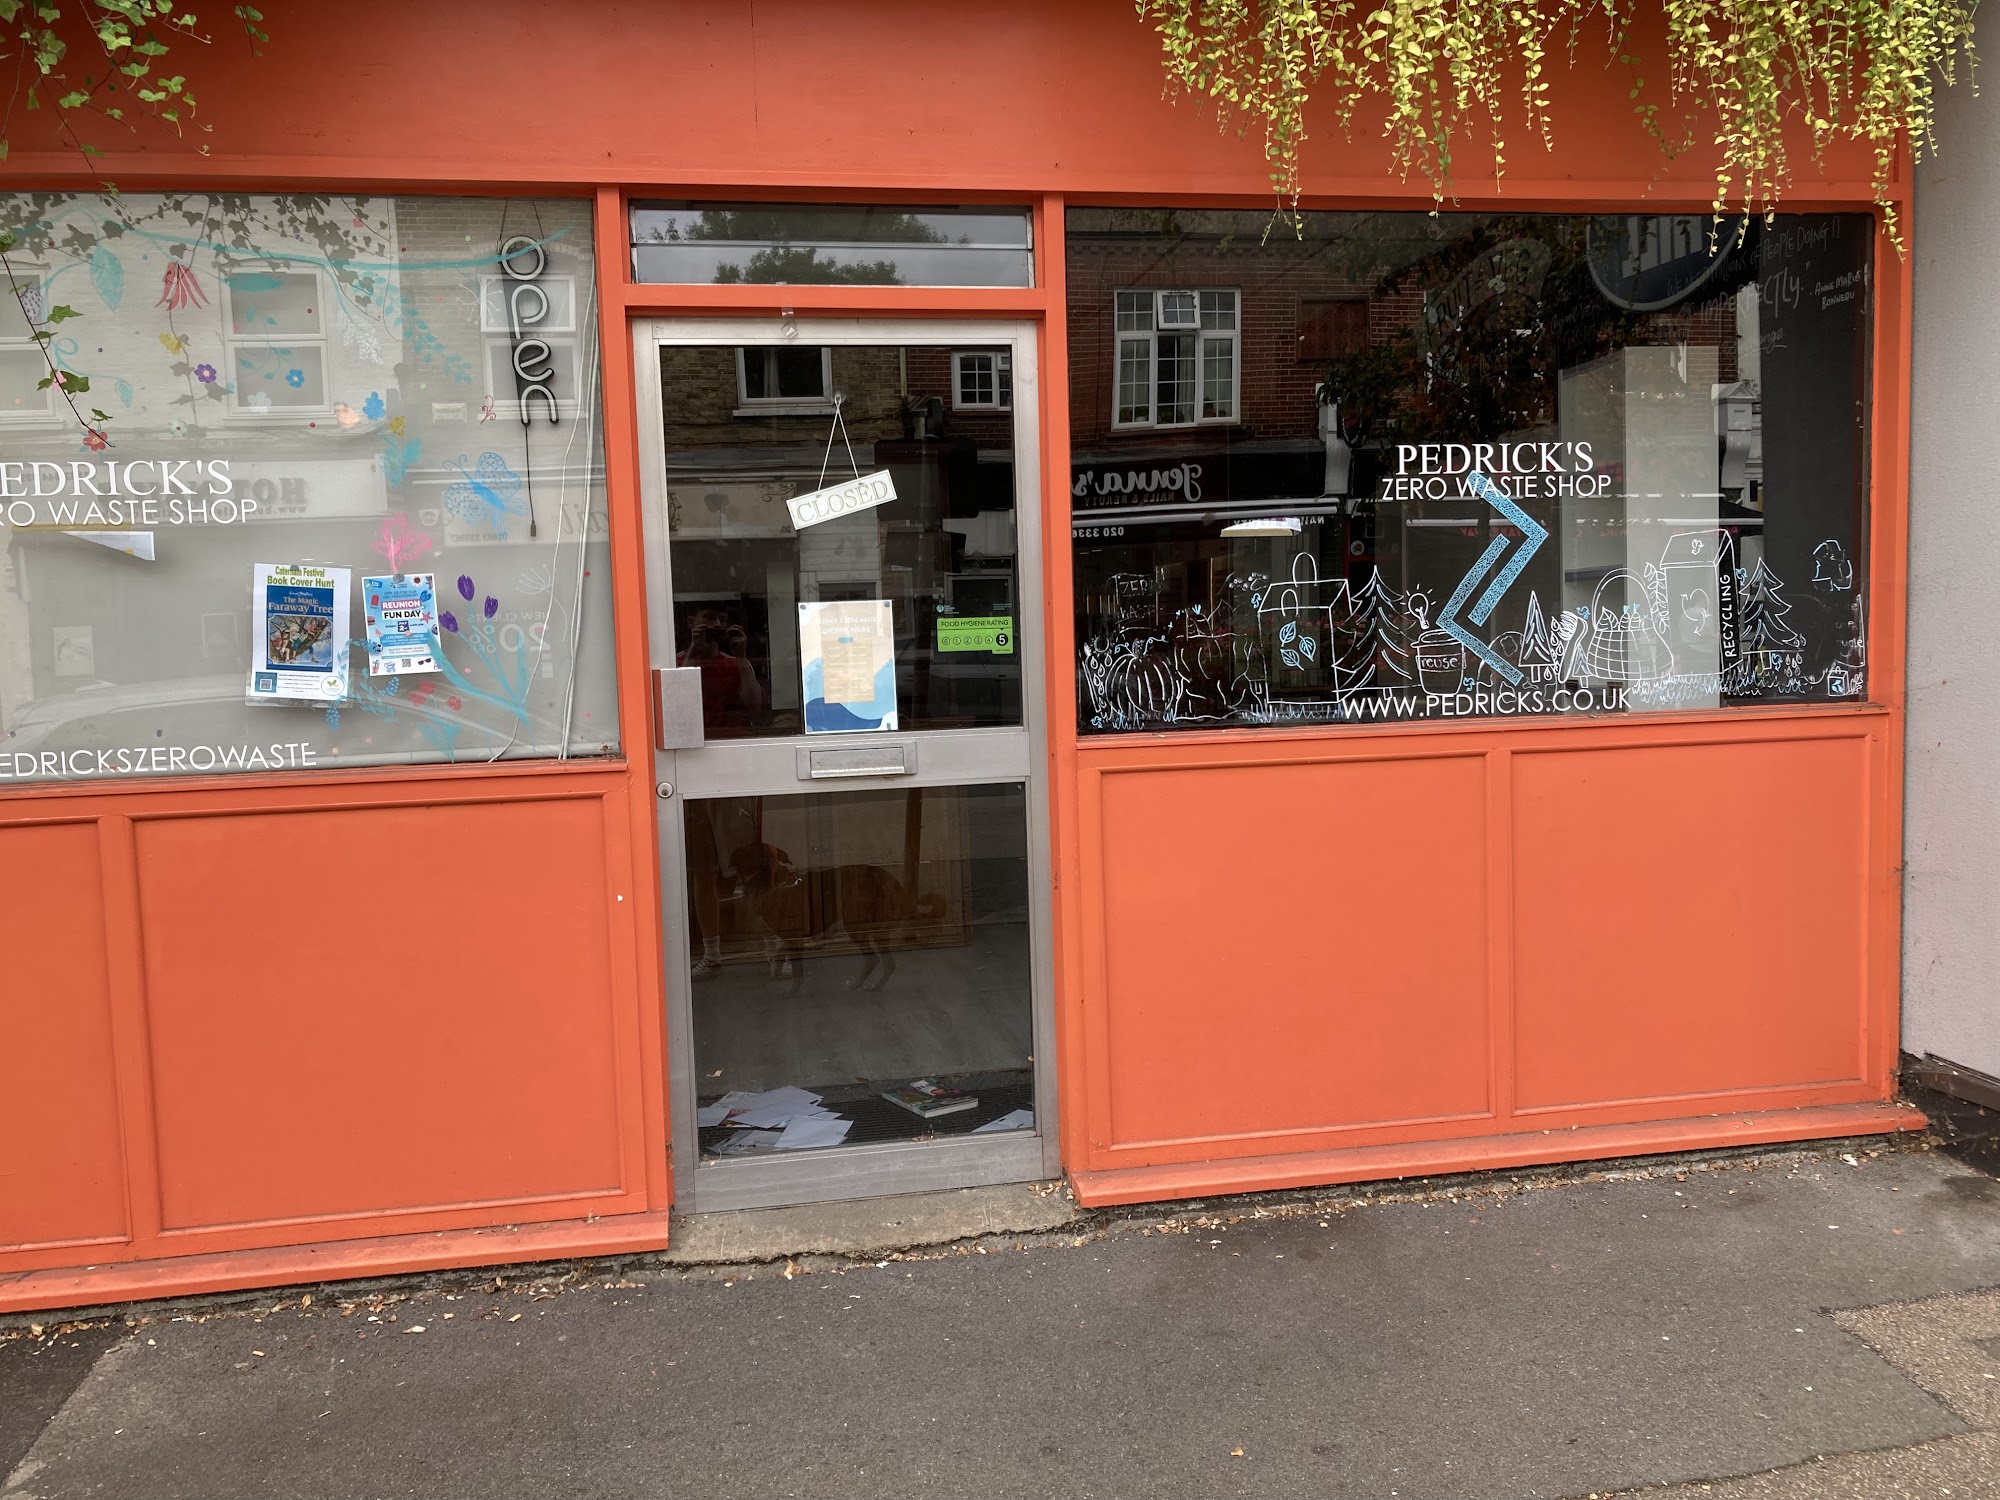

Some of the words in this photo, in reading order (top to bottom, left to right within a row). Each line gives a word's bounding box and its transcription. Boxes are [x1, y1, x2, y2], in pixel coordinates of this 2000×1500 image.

[500, 234, 558, 426] open
[1395, 441, 1595, 475] PEDRICK'S
[1382, 475, 1449, 501] ZERO
[1456, 474, 1538, 499] WASTE
[1544, 474, 1612, 498] SHOP
[796, 479, 888, 523] CLOSED
[48, 500, 159, 526] WASTE
[170, 498, 258, 524] SHOP
[303, 568, 325, 579] Festival
[267, 575, 288, 586] Book
[290, 576, 313, 587] Cover
[315, 578, 335, 588] Hunt
[283, 596, 296, 604] The
[297, 597, 318, 606] Magic
[382, 600, 421, 609] REUNION
[268, 602, 310, 615] Faraway
[311, 604, 333, 614] Tree
[384, 611, 403, 619] FUN
[404, 610, 421, 618] DAY
[1719, 573, 1737, 658] RECYCLING
[850, 626, 871, 634] HOURS
[940, 620, 960, 628] FOOD
[961, 619, 987, 627] HYGIENE
[1342, 686, 1632, 719] WWW.PEDRICKS.CO.UK
